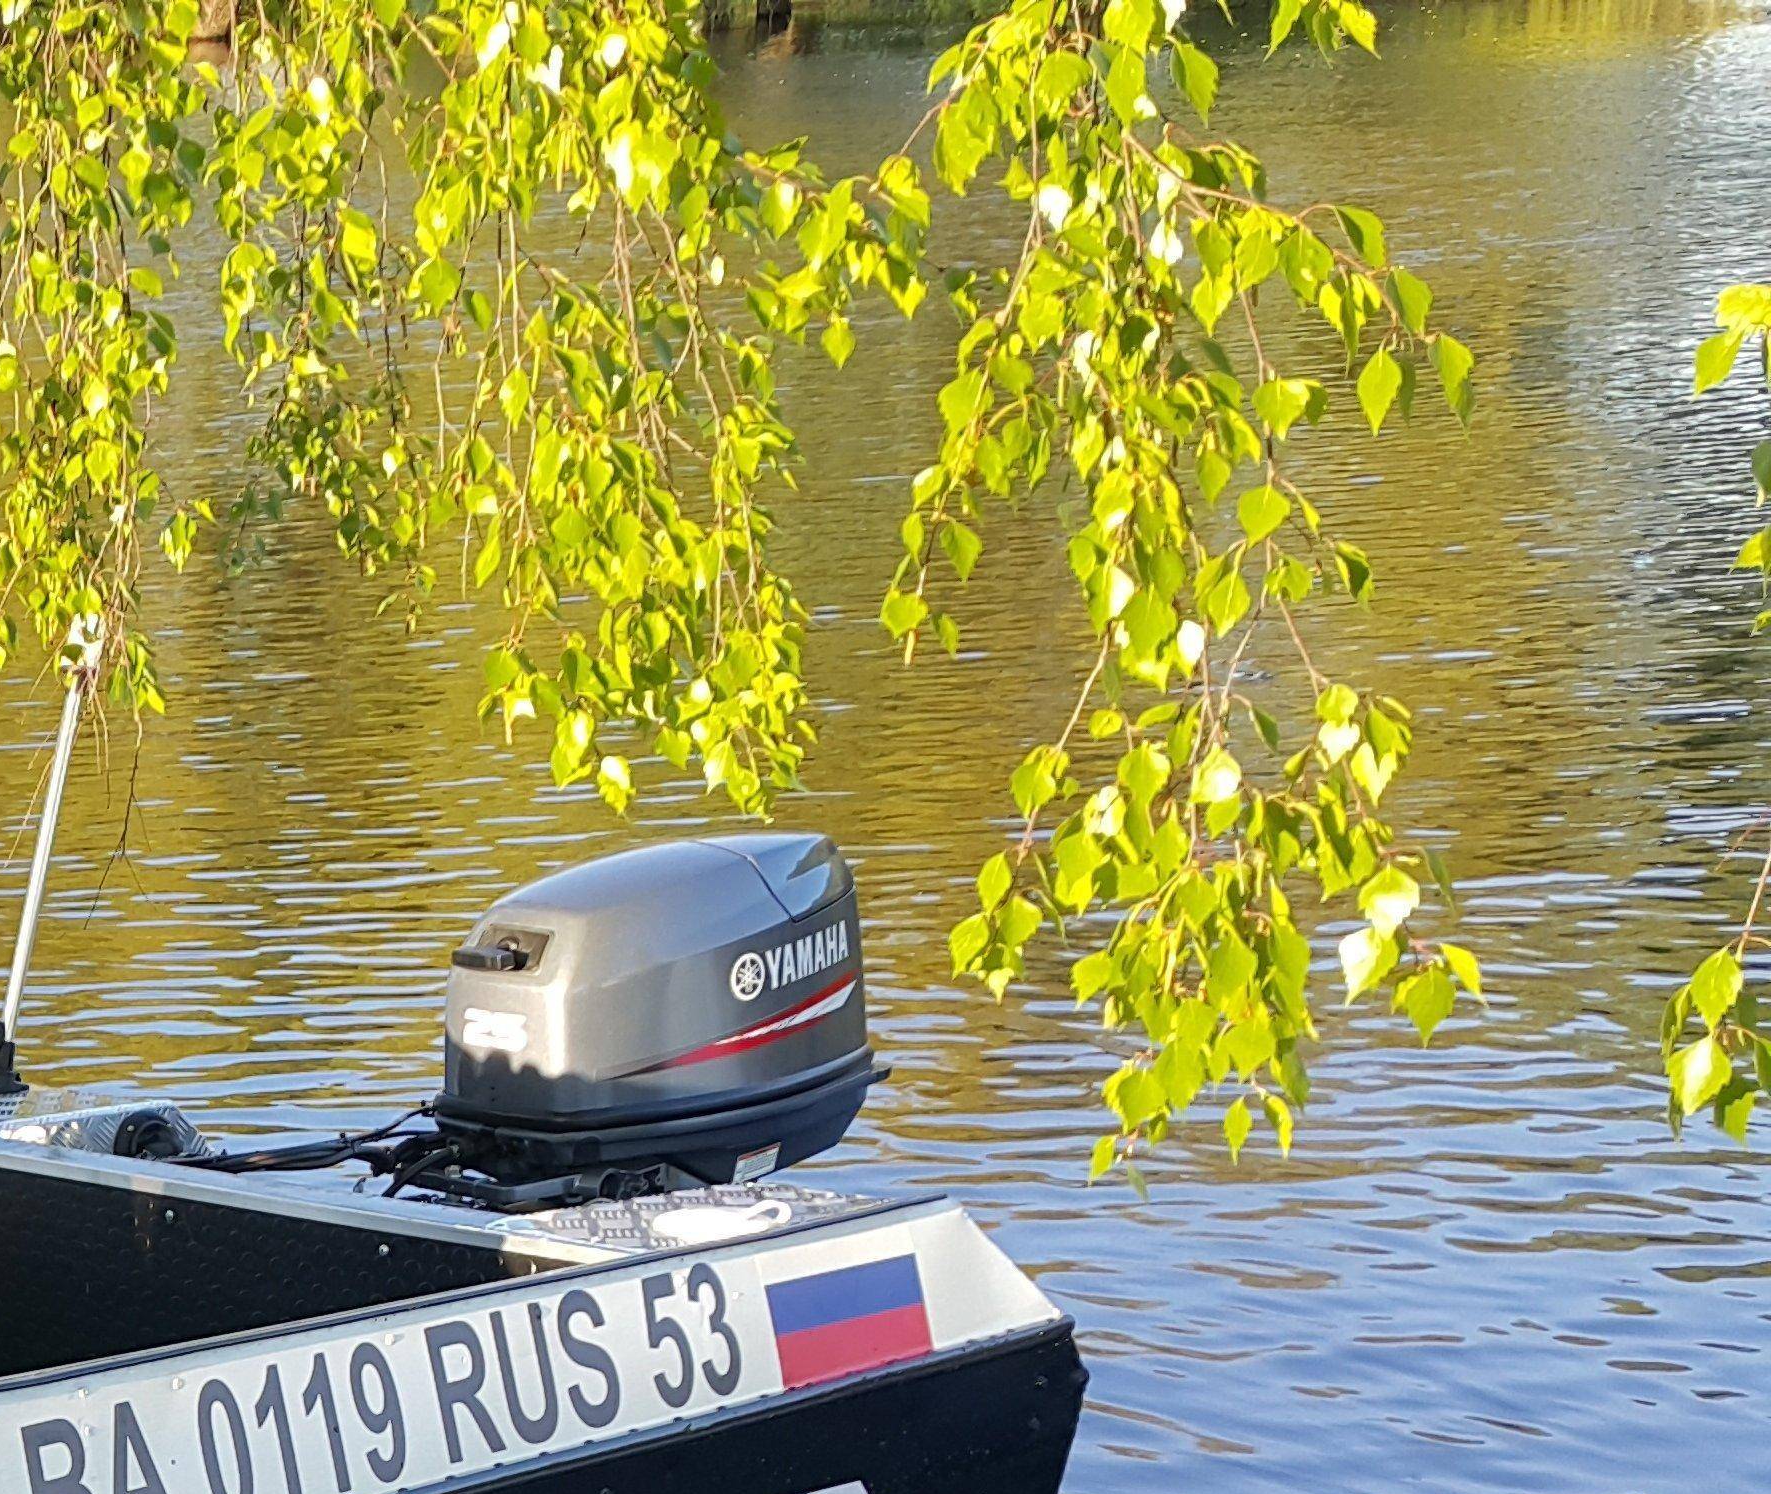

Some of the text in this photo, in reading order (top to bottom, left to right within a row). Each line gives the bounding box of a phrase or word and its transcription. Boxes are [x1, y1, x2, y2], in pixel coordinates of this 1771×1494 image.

[765, 920, 849, 990] YAMAHA
[423, 1289, 620, 1464] RUS
[641, 1262, 742, 1409] 53
